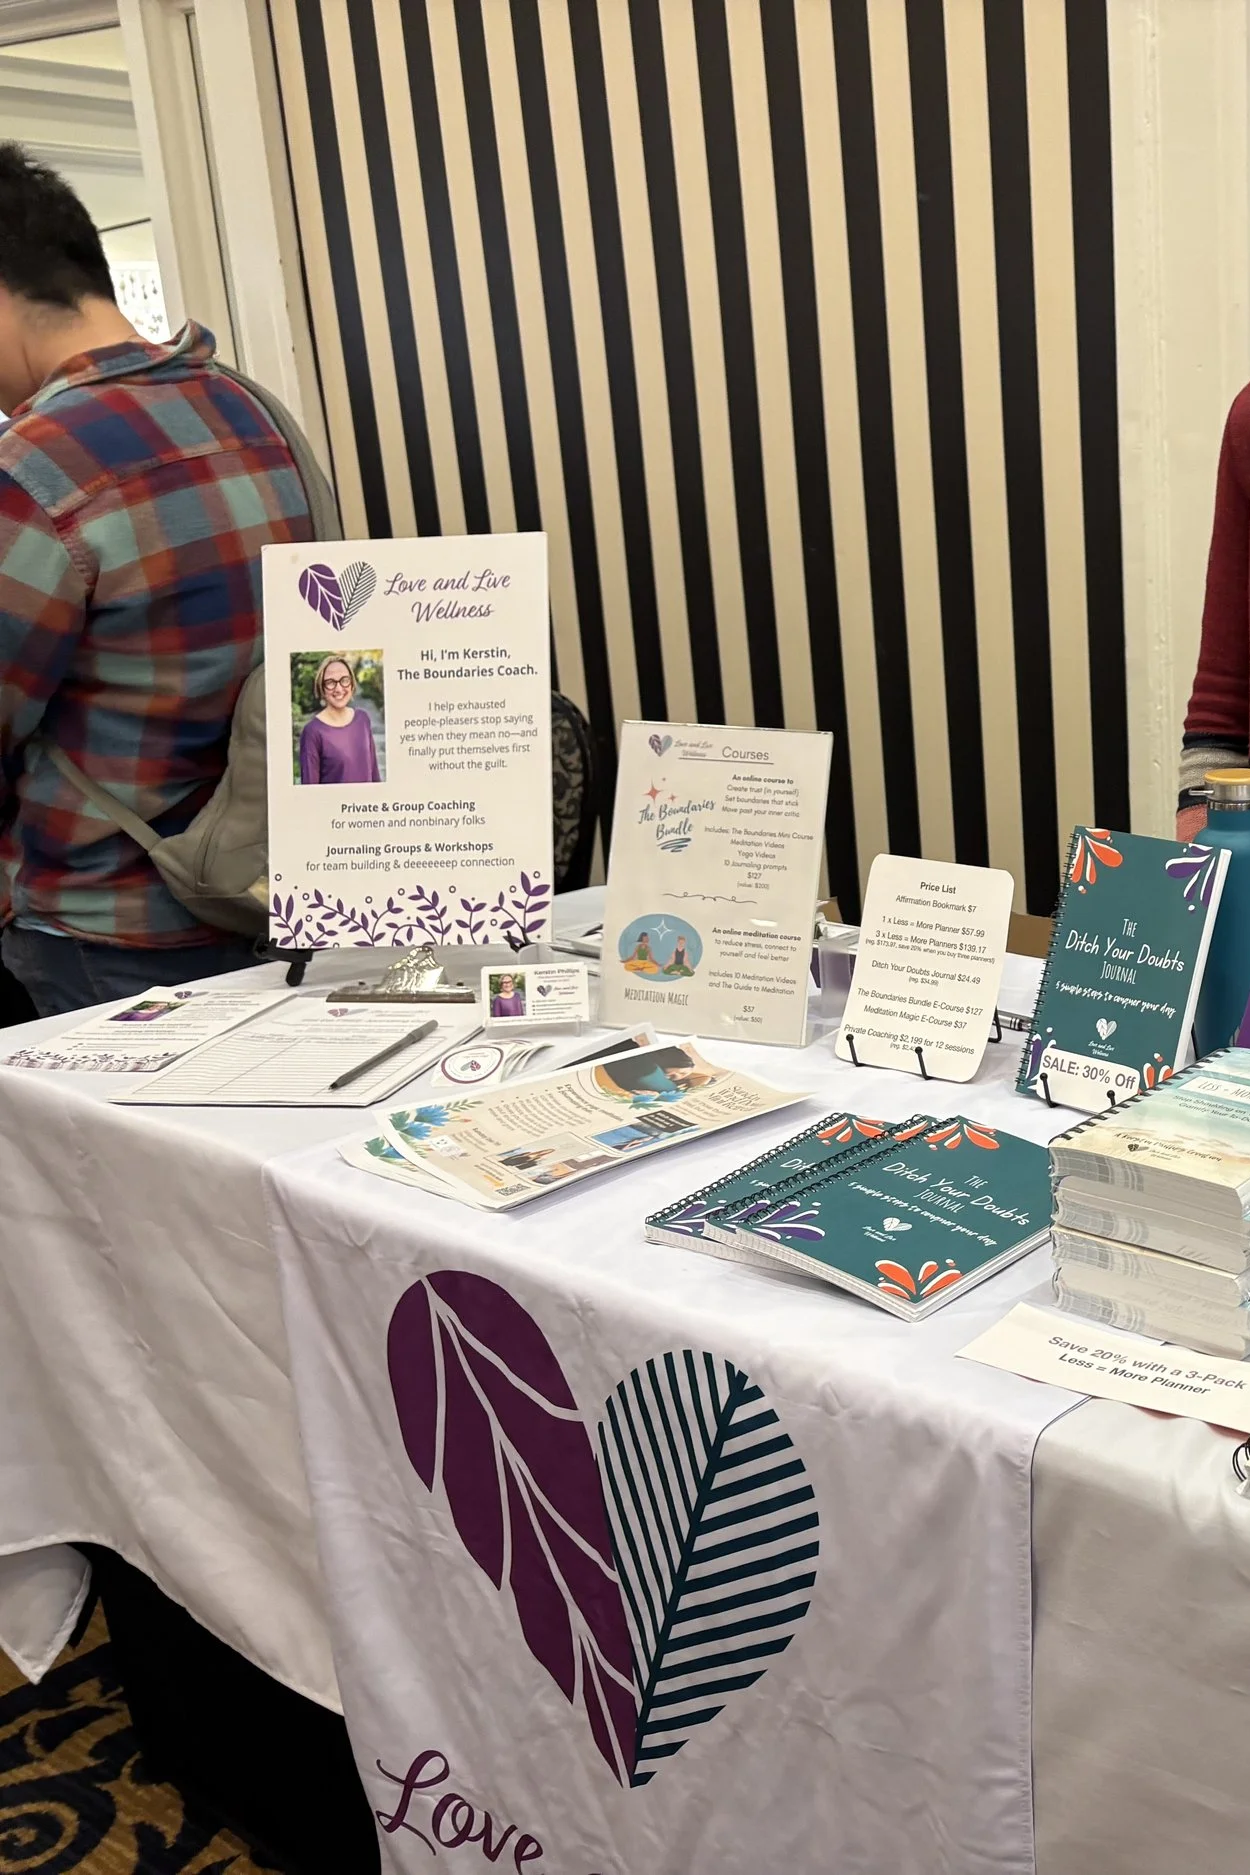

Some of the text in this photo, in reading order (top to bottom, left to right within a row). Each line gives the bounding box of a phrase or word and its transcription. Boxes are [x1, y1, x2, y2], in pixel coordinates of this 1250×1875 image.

[383, 568, 510, 596] Love and Live
[410, 598, 494, 623] Wellness
[420, 649, 436, 662] Hi,
[463, 646, 510, 659] Kerstin,
[397, 663, 537, 680] The Boundaries Coach.
[428, 698, 505, 713] I help exhausted
[404, 713, 533, 730] people-pleasers stop saying
[399, 733, 416, 744] yes
[417, 731, 444, 742] when
[445, 731, 467, 742] they
[468, 730, 496, 739] mean
[408, 742, 530, 758] finally put themselves first
[721, 745, 769, 760] Courses
[428, 758, 507, 771] without the guilt.
[341, 799, 475, 814] Private & Group Coaching
[331, 814, 486, 829] for women and nonbinary folks
[325, 841, 493, 857] Journaling Groups & Workshops
[306, 861, 320, 871] for
[322, 862, 348, 871] team
[350, 859, 390, 872] building
[392, 858, 400, 869] &
[460, 856, 514, 867] connection
[920, 881, 956, 894] Price List
[895, 894, 976, 913] Affirmation Bookmark $7
[1123, 918, 1138, 938] THE
[1064, 929, 1184, 971] Ditch Your Doubts
[871, 959, 980, 984] Ditch Your Doubts Journal $24.49
[1100, 960, 1138, 984] JOURNAL
[624, 987, 688, 1006] MEDITATION MAGIC
[1042, 1056, 1136, 1090] SALE: 30% Off
[964, 1176, 989, 1189] THE
[882, 1162, 1029, 1225] Ditch Your Doubts
[914, 1189, 966, 1214] JOURNAL
[1048, 1336, 1088, 1353] Save
[1090, 1349, 1127, 1363] 20%
[1132, 1360, 1167, 1372] with
[1185, 1370, 1246, 1389] 3-Pack
[1058, 1353, 1094, 1368] Less
[1108, 1367, 1148, 1381] More
[1150, 1376, 1210, 1394] Planner
[376, 1750, 543, 1875] Love
